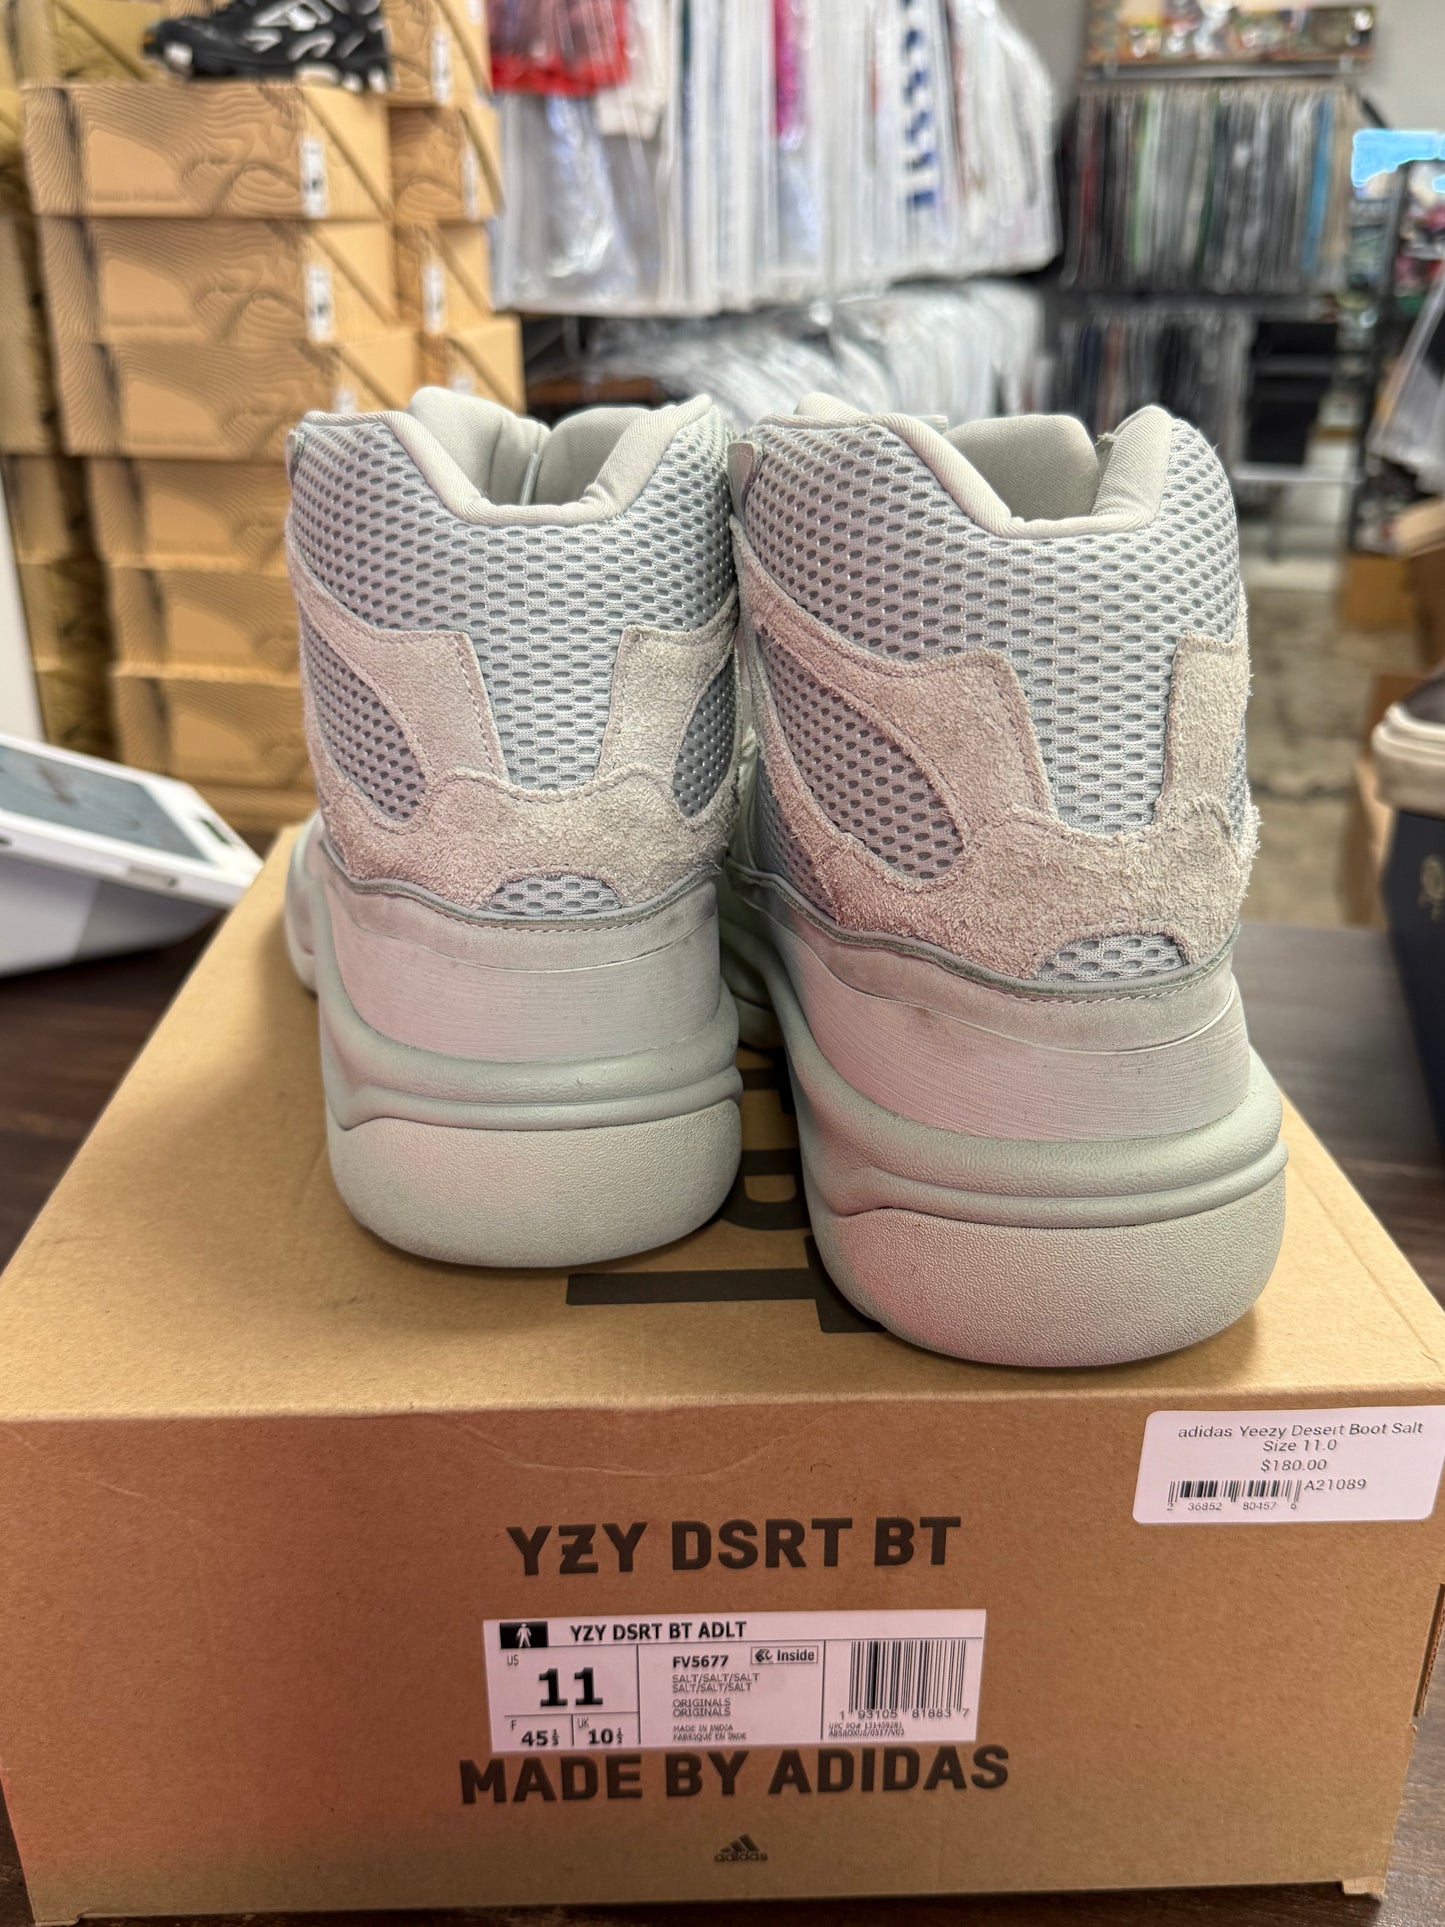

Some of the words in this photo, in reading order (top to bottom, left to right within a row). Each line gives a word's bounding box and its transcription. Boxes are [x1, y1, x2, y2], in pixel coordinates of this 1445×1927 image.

[1178, 1425, 1233, 1438] adidas
[1239, 1425, 1287, 1439] Yeezy
[1291, 1424, 1345, 1437] Desert
[1349, 1422, 1387, 1435] Boot
[1391, 1421, 1424, 1434] Salt
[1262, 1439, 1297, 1452] Size
[1303, 1438, 1338, 1451] 11.0
[1260, 1458, 1328, 1473] $180.00
[1303, 1478, 1368, 1492] A21089
[671, 1517, 853, 1571] DSRT
[874, 1516, 962, 1567] BT
[570, 1624, 607, 1642] YZY
[613, 1623, 663, 1641] DSRT
[669, 1622, 693, 1639] BT
[698, 1621, 747, 1639] ADLT
[506, 1654, 520, 1666] US
[672, 1655, 729, 1668] FV5677
[777, 1649, 815, 1662] Inside
[672, 1672, 761, 1684] SALT/SALT/SALT
[538, 1667, 604, 1707] 11
[672, 1682, 753, 1693] SALT/SALT/SALT
[672, 1698, 731, 1707] ORIGINALS
[672, 1707, 731, 1717] ORIGINALS
[858, 1710, 898, 1720] 93105
[911, 1708, 951, 1718] 81883
[962, 1708, 970, 1718] 7
[510, 1720, 517, 1731] F
[577, 1718, 590, 1729] UK
[459, 1755, 644, 1804] MADE
[665, 1750, 750, 1797] BY
[768, 1745, 1010, 1796] ADIDAS
[714, 1850, 769, 1862] adidas
